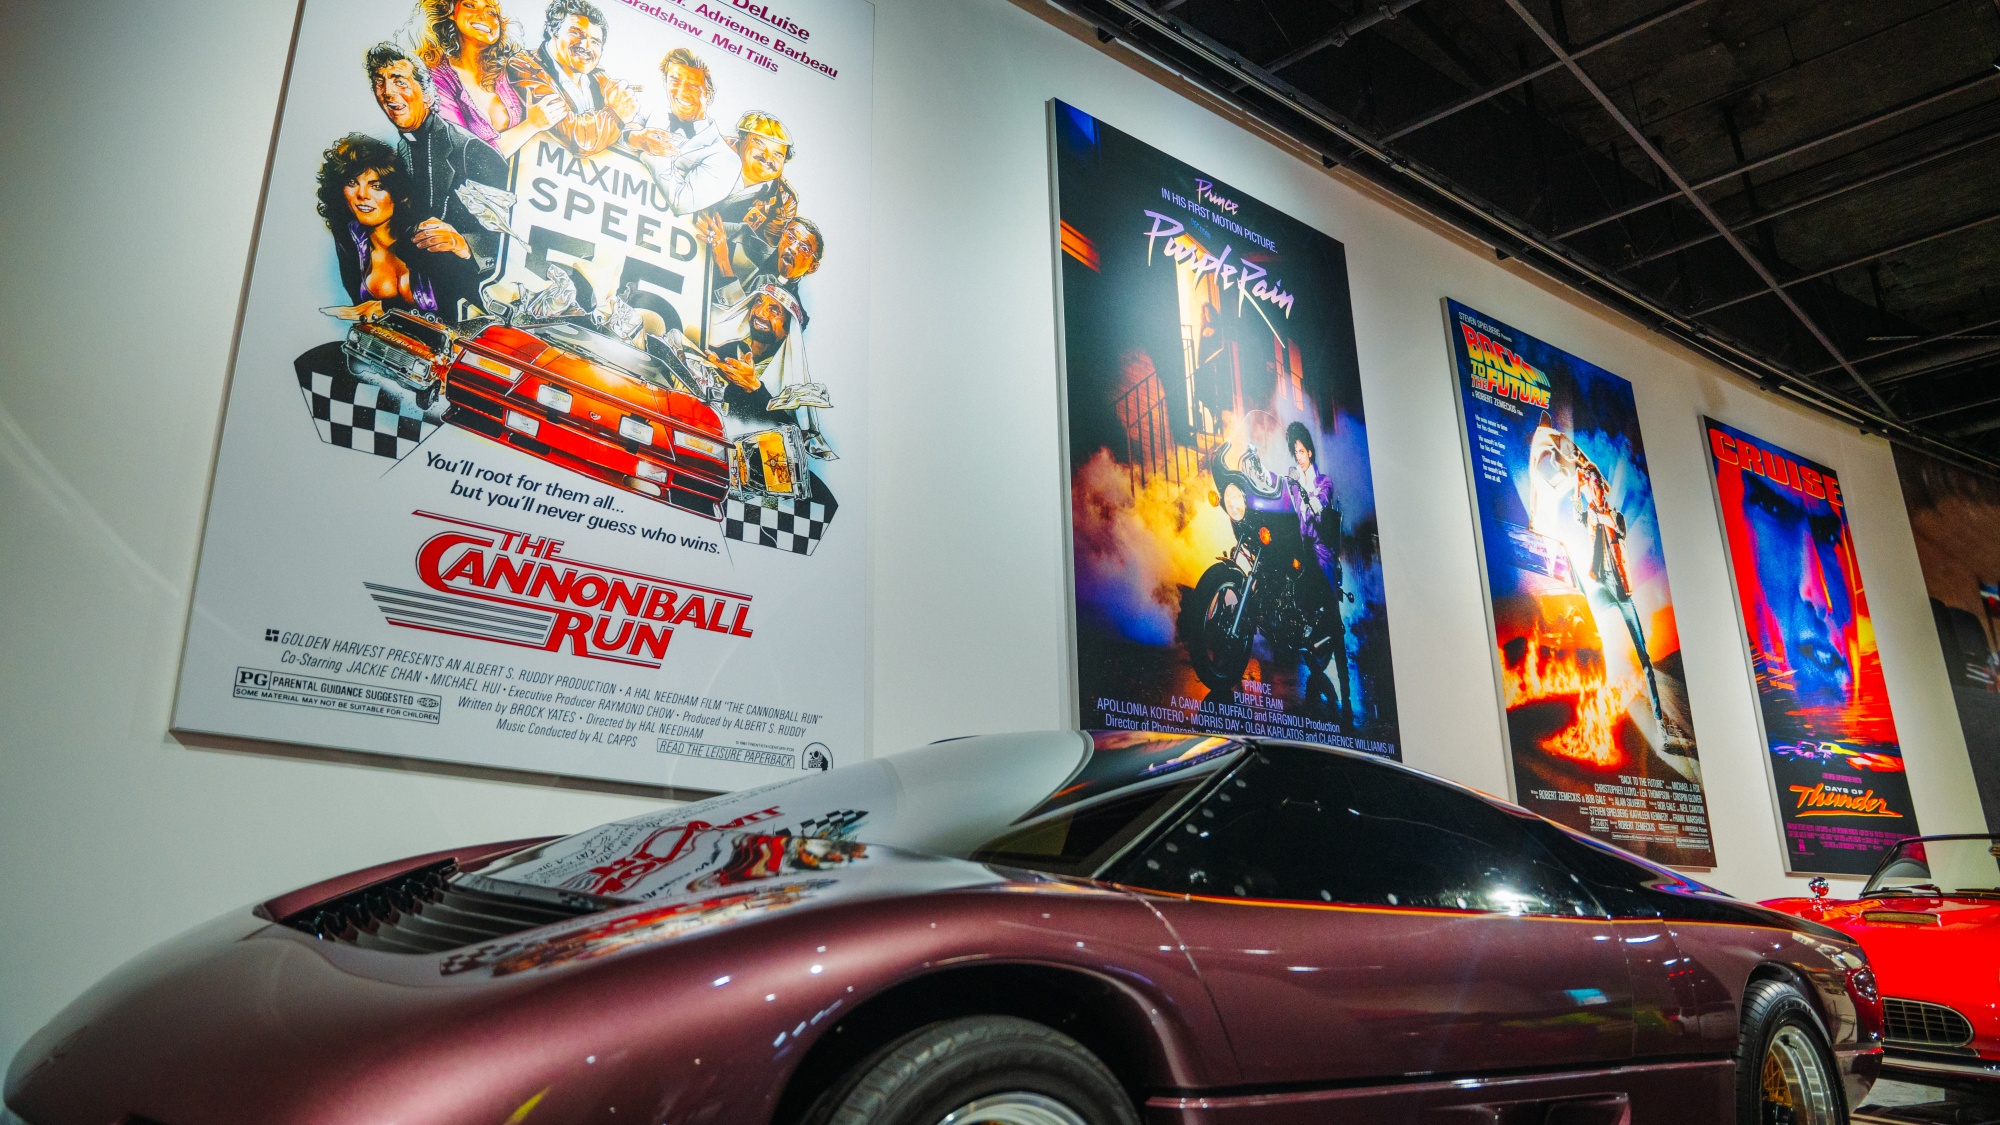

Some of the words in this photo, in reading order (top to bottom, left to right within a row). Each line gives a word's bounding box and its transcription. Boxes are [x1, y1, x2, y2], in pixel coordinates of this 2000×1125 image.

[695, 3, 770, 45] Adrienne
[773, 39, 838, 78] Barbeau
[711, 33, 743, 55] Mel
[746, 47, 779, 73] Tillis
[536, 140, 671, 213] MAXIMU
[1194, 178, 1239, 215] Prince
[528, 176, 698, 262] SPEED
[1161, 187, 1171, 201] IN
[1172, 193, 1187, 209] HIS
[1188, 200, 1211, 221] FIRST
[1212, 212, 1243, 237] MOTION
[1143, 209, 1238, 290] Purple
[1237, 257, 1295, 320] Rain
[1460, 321, 1542, 384] BACK
[1471, 359, 1487, 378] TO
[1471, 375, 1488, 391] THE
[1487, 368, 1551, 409] FUTURE
[426, 451, 473, 477] You'll
[475, 467, 514, 487] root
[517, 474, 543, 493] for
[546, 482, 590, 505] them
[593, 495, 625, 513] all...
[1708, 428, 1844, 507] CRUISE
[450, 480, 483, 499] but
[487, 490, 534, 513] you'll
[536, 503, 585, 525] never
[587, 515, 637, 537] guess
[640, 525, 677, 545] who
[680, 535, 721, 555] wins.
[499, 531, 564, 558] THE
[415, 531, 753, 638] CANNONBALL
[546, 609, 674, 660] RUN
[239, 671, 268, 687] PG
[273, 675, 318, 693] PARENTAL
[320, 682, 363, 700] GUIDANCE
[365, 688, 414, 707] SUGGESTED
[281, 631, 331, 651] GOLDEN
[332, 639, 385, 660] HARVEST
[387, 647, 444, 669] PRESENTS
[446, 656, 462, 672] AN
[463, 659, 505, 678] ALBERT
[505, 665, 515, 680] S.
[519, 667, 553, 686] RUDDY
[555, 673, 616, 695] PRODUCTION
[625, 684, 632, 698] A
[634, 685, 650, 700] HAL
[654, 688, 699, 708] NEEDHAM
[700, 695, 721, 711] FILM
[746, 702, 800, 723] CANNONBALL
[281, 650, 342, 674] Co-Starring
[346, 659, 387, 678] JACKIE
[390, 666, 422, 683] CHAN
[431, 672, 477, 691] MICHAEL
[481, 679, 502, 695] HUI
[508, 683, 553, 702] Executive
[555, 690, 596, 709] Producer
[599, 696, 645, 716] RAYMOND
[646, 703, 675, 720] CHOW
[682, 708, 721, 727] Produced
[722, 714, 732, 730] by
[733, 715, 766, 733] ALBERT
[768, 721, 776, 735] S.
[778, 722, 806, 739] RUDDY
[1243, 680, 1272, 695] PRINCE
[236, 687, 259, 698] SOME
[261, 691, 298, 703] MATERIAL
[302, 696, 318, 706] MAY
[320, 699, 336, 708] NOT
[338, 701, 348, 710] BE
[350, 703, 384, 715] SUITABLE
[386, 708, 400, 717] FOR
[402, 710, 439, 722] CHILDREN
[457, 695, 493, 713] Written
[495, 700, 508, 717] by
[510, 702, 545, 720] BROCK
[547, 707, 576, 724] YATES
[586, 712, 626, 730] Directed
[627, 717, 637, 734] by
[638, 719, 656, 734] HAL
[658, 721, 704, 740] NEEDHAM
[1171, 695, 1177, 707] A
[1179, 696, 1218, 715] CAVALLO,
[1219, 704, 1252, 720] RUFFALO
[1254, 711, 1267, 722] and
[1269, 711, 1304, 728] FARGNOLI
[1306, 718, 1340, 733] Production
[1234, 692, 1264, 707] PURPLE
[1266, 699, 1283, 710] RAIN
[496, 717, 526, 734] Music
[528, 721, 578, 741] Conducted
[579, 728, 591, 744] by
[592, 729, 604, 744] AL
[606, 731, 638, 749] CAPPS
[1097, 697, 1149, 717] APOLLONIA
[1150, 706, 1185, 722] KOTERO
[1190, 713, 1223, 729] MORRIS
[1225, 718, 1240, 731] DAY
[1245, 721, 1266, 736] OLGA
[1267, 725, 1305, 741] KARLATOS
[1305, 732, 1318, 743] and
[1319, 732, 1354, 749] CLARENCE
[1354, 738, 1387, 754] WILLIAMS
[1105, 713, 1139, 731] Director
[1141, 720, 1150, 732] of
[659, 739, 684, 755] READ
[686, 743, 704, 757] THE
[705, 745, 742, 762] LEISURE
[744, 750, 793, 768] PAPERBACK
[1789, 782, 1888, 813] Thunder
[1824, 785, 1849, 794] DAYS
